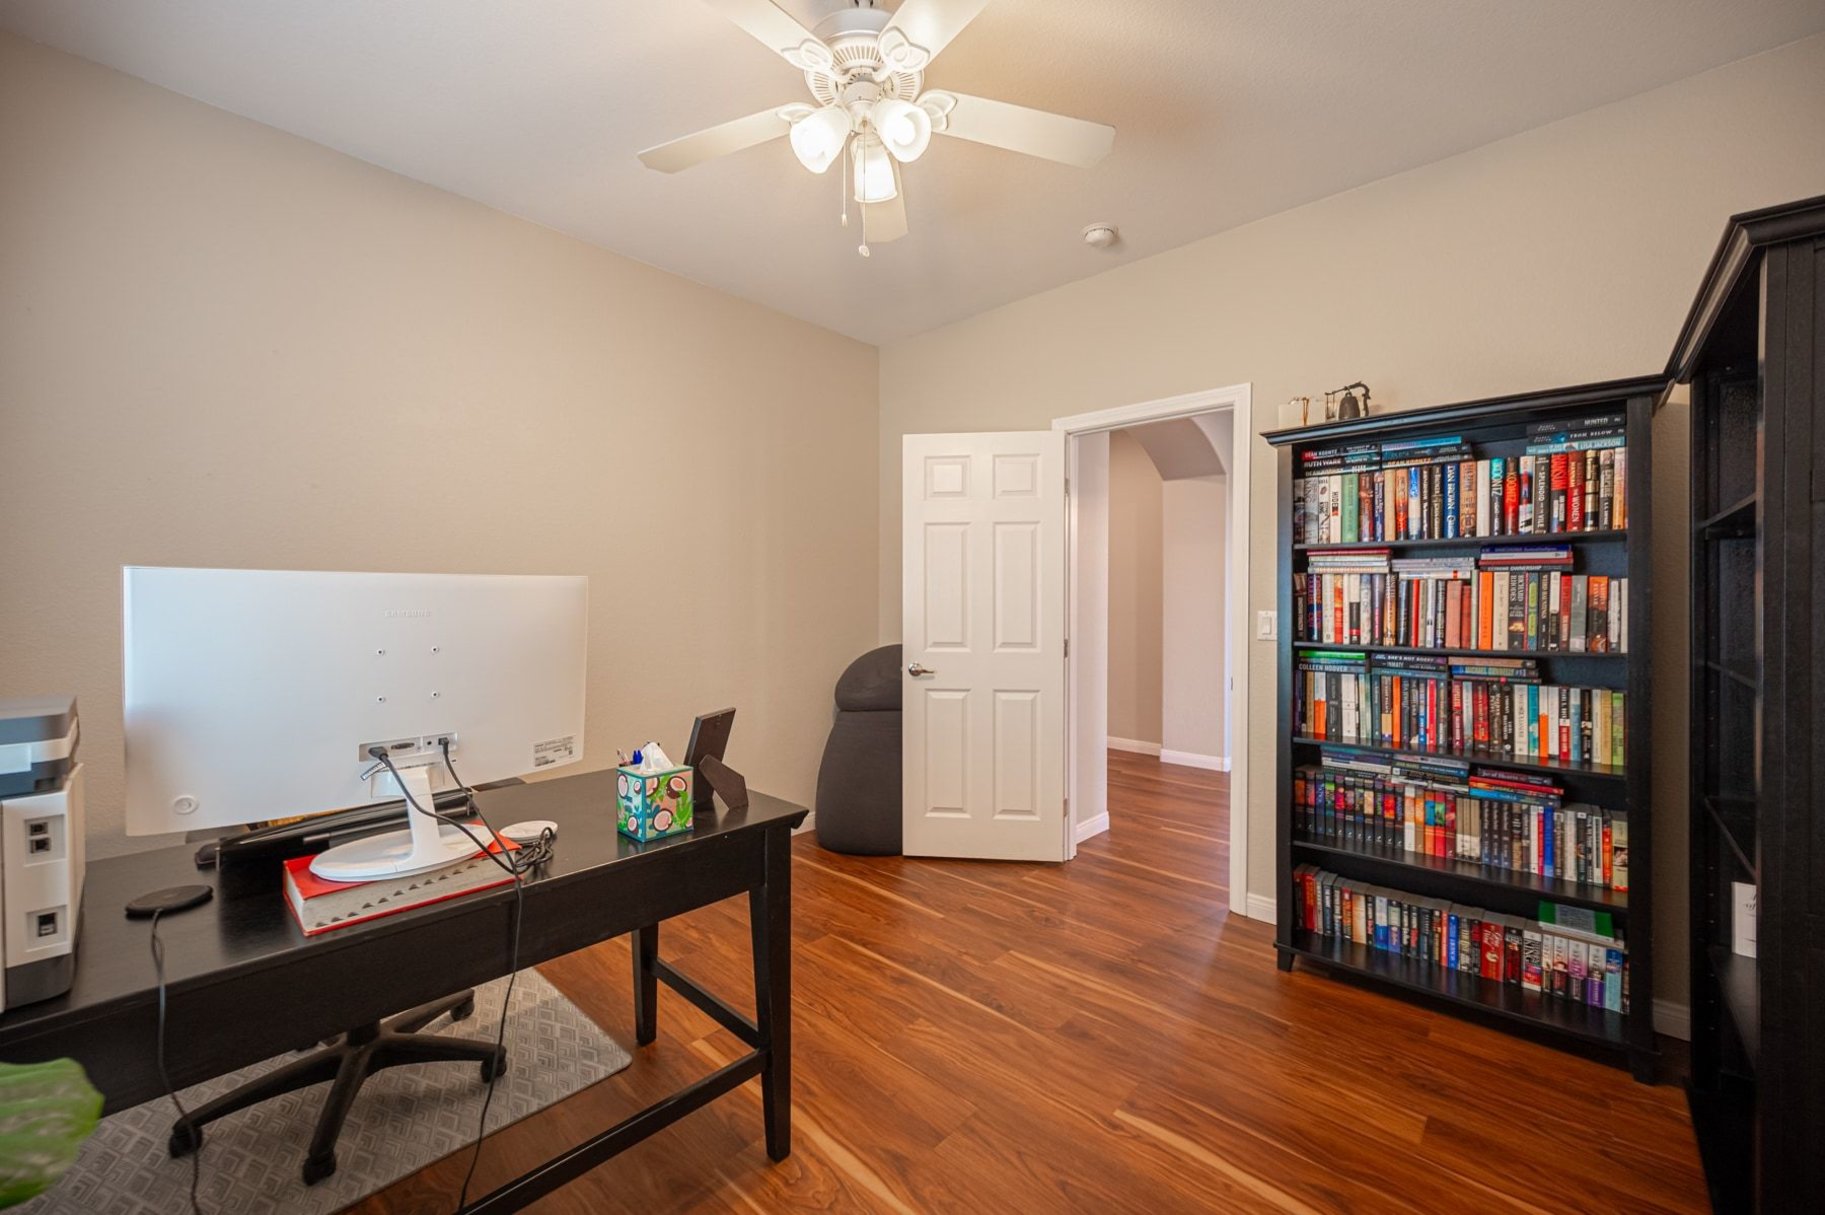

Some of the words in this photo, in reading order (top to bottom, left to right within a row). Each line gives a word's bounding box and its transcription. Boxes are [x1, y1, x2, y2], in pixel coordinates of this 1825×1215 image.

[1584, 417, 1609, 426] HUNTED
[1594, 439, 1621, 448] JACKSON
[1322, 458, 1342, 466] WARE
[1447, 465, 1456, 482] DAN
[1505, 472, 1517, 504] KOONTZ
[1537, 472, 1546, 502] SPLENDID
[1331, 491, 1339, 507] HIDE
[1447, 483, 1456, 510] BROWN
[1571, 496, 1580, 523] WOMEN
[1537, 514, 1545, 529] VILE
[1299, 663, 1324, 671] COLLEEN
